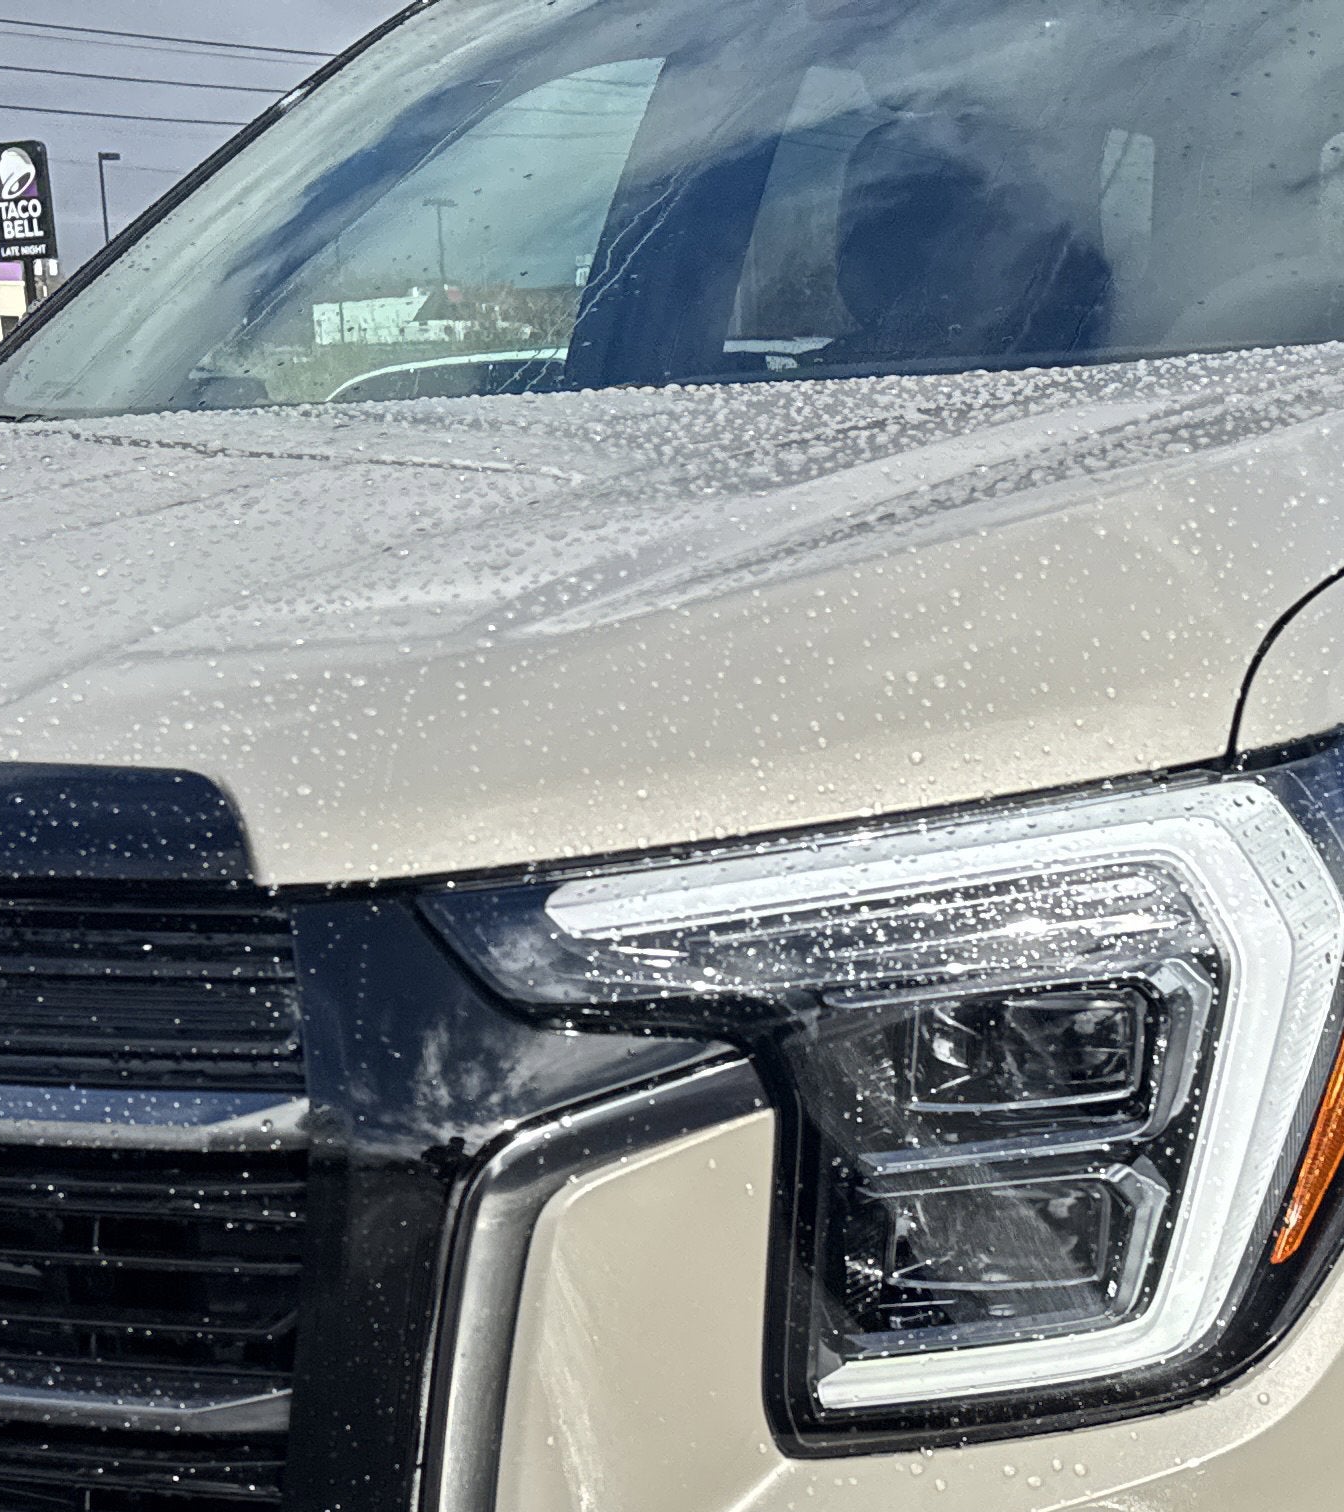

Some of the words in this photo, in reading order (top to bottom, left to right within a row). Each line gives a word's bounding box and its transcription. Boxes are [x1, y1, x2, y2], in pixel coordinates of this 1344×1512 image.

[3, 218, 44, 240] BELL
[1, 246, 20, 257] LATE
[21, 244, 47, 256] NIGHT
